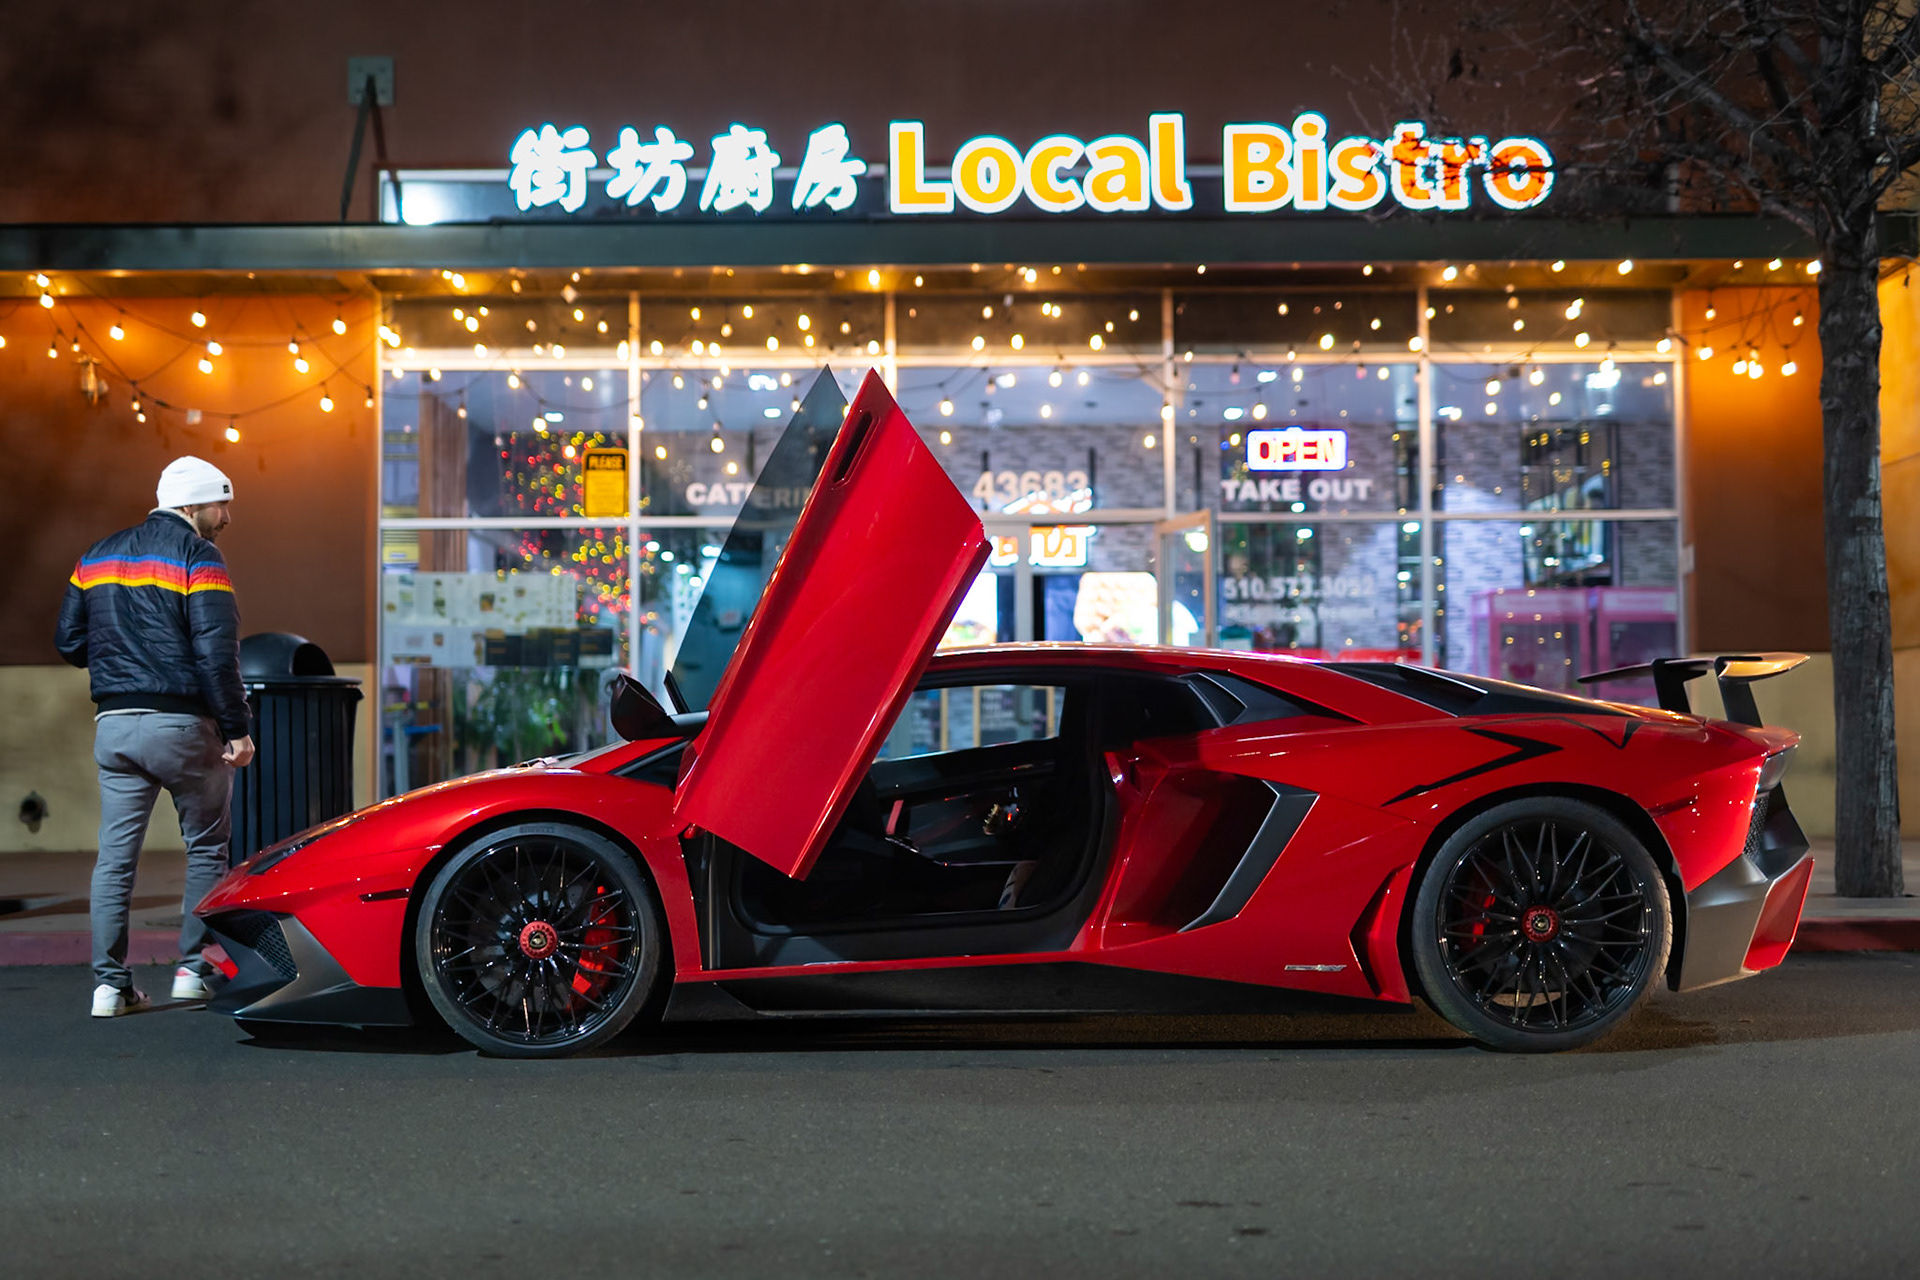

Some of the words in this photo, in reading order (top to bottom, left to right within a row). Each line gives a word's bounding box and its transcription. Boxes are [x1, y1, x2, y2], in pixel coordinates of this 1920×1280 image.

[889, 111, 1193, 212] Local
[1223, 110, 1555, 211] Bistro
[588, 454, 623, 469] PLEASE
[1252, 434, 1341, 466] OPEN
[1220, 479, 1300, 501] TAKE
[1308, 479, 1373, 501] OUT
